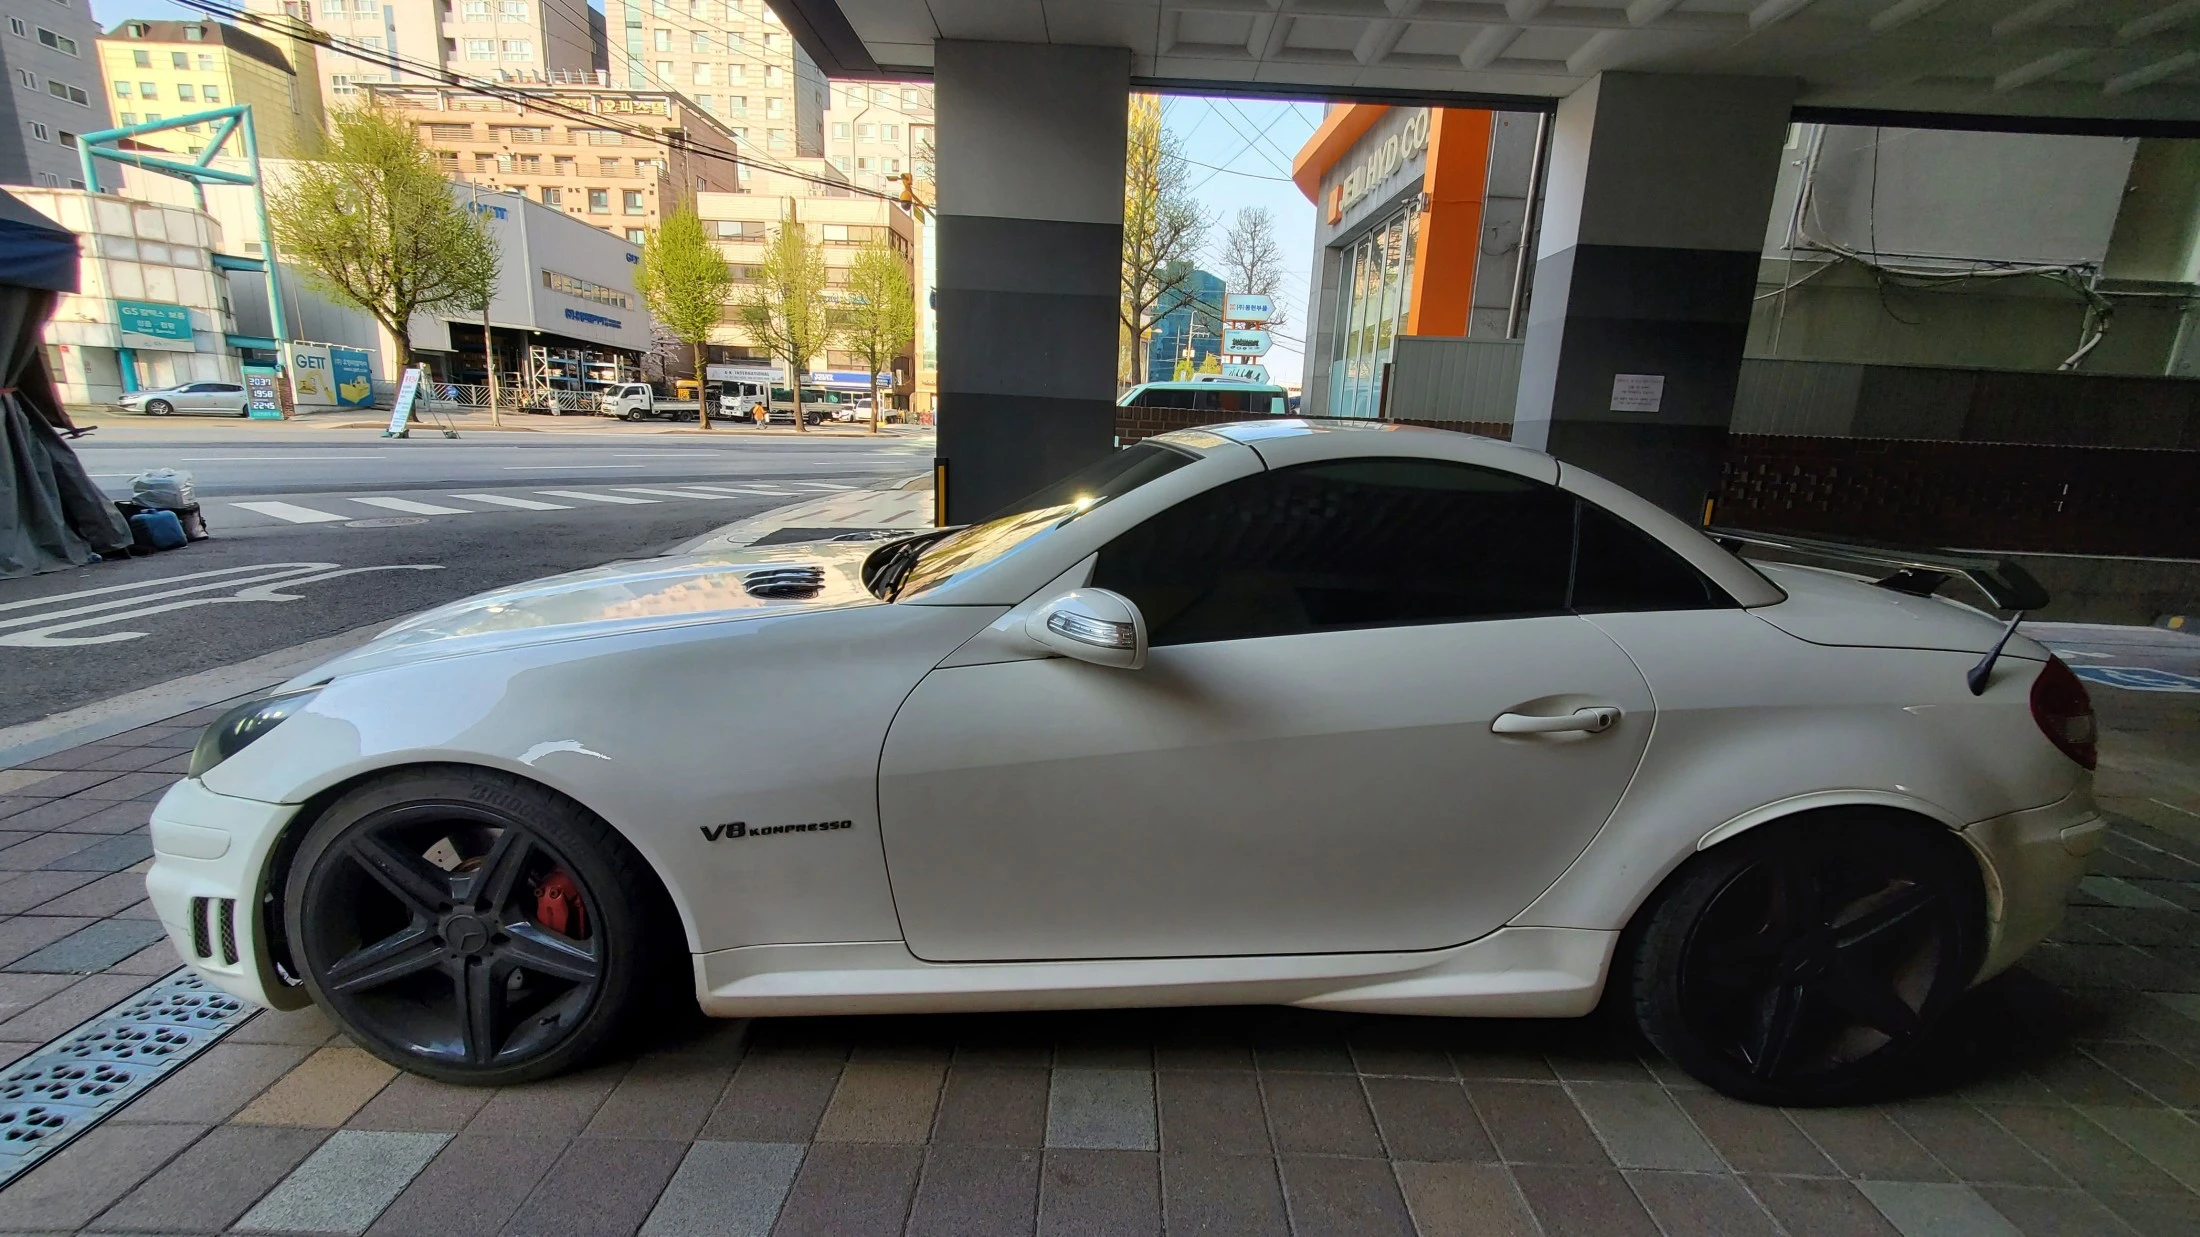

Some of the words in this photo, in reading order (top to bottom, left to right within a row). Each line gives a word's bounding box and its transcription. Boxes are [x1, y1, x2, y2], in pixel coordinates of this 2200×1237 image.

[253, 390, 273, 398] 1958
[253, 401, 276, 410] 2245
[700, 821, 746, 842] V8
[749, 819, 853, 837] KOMPRESSO
